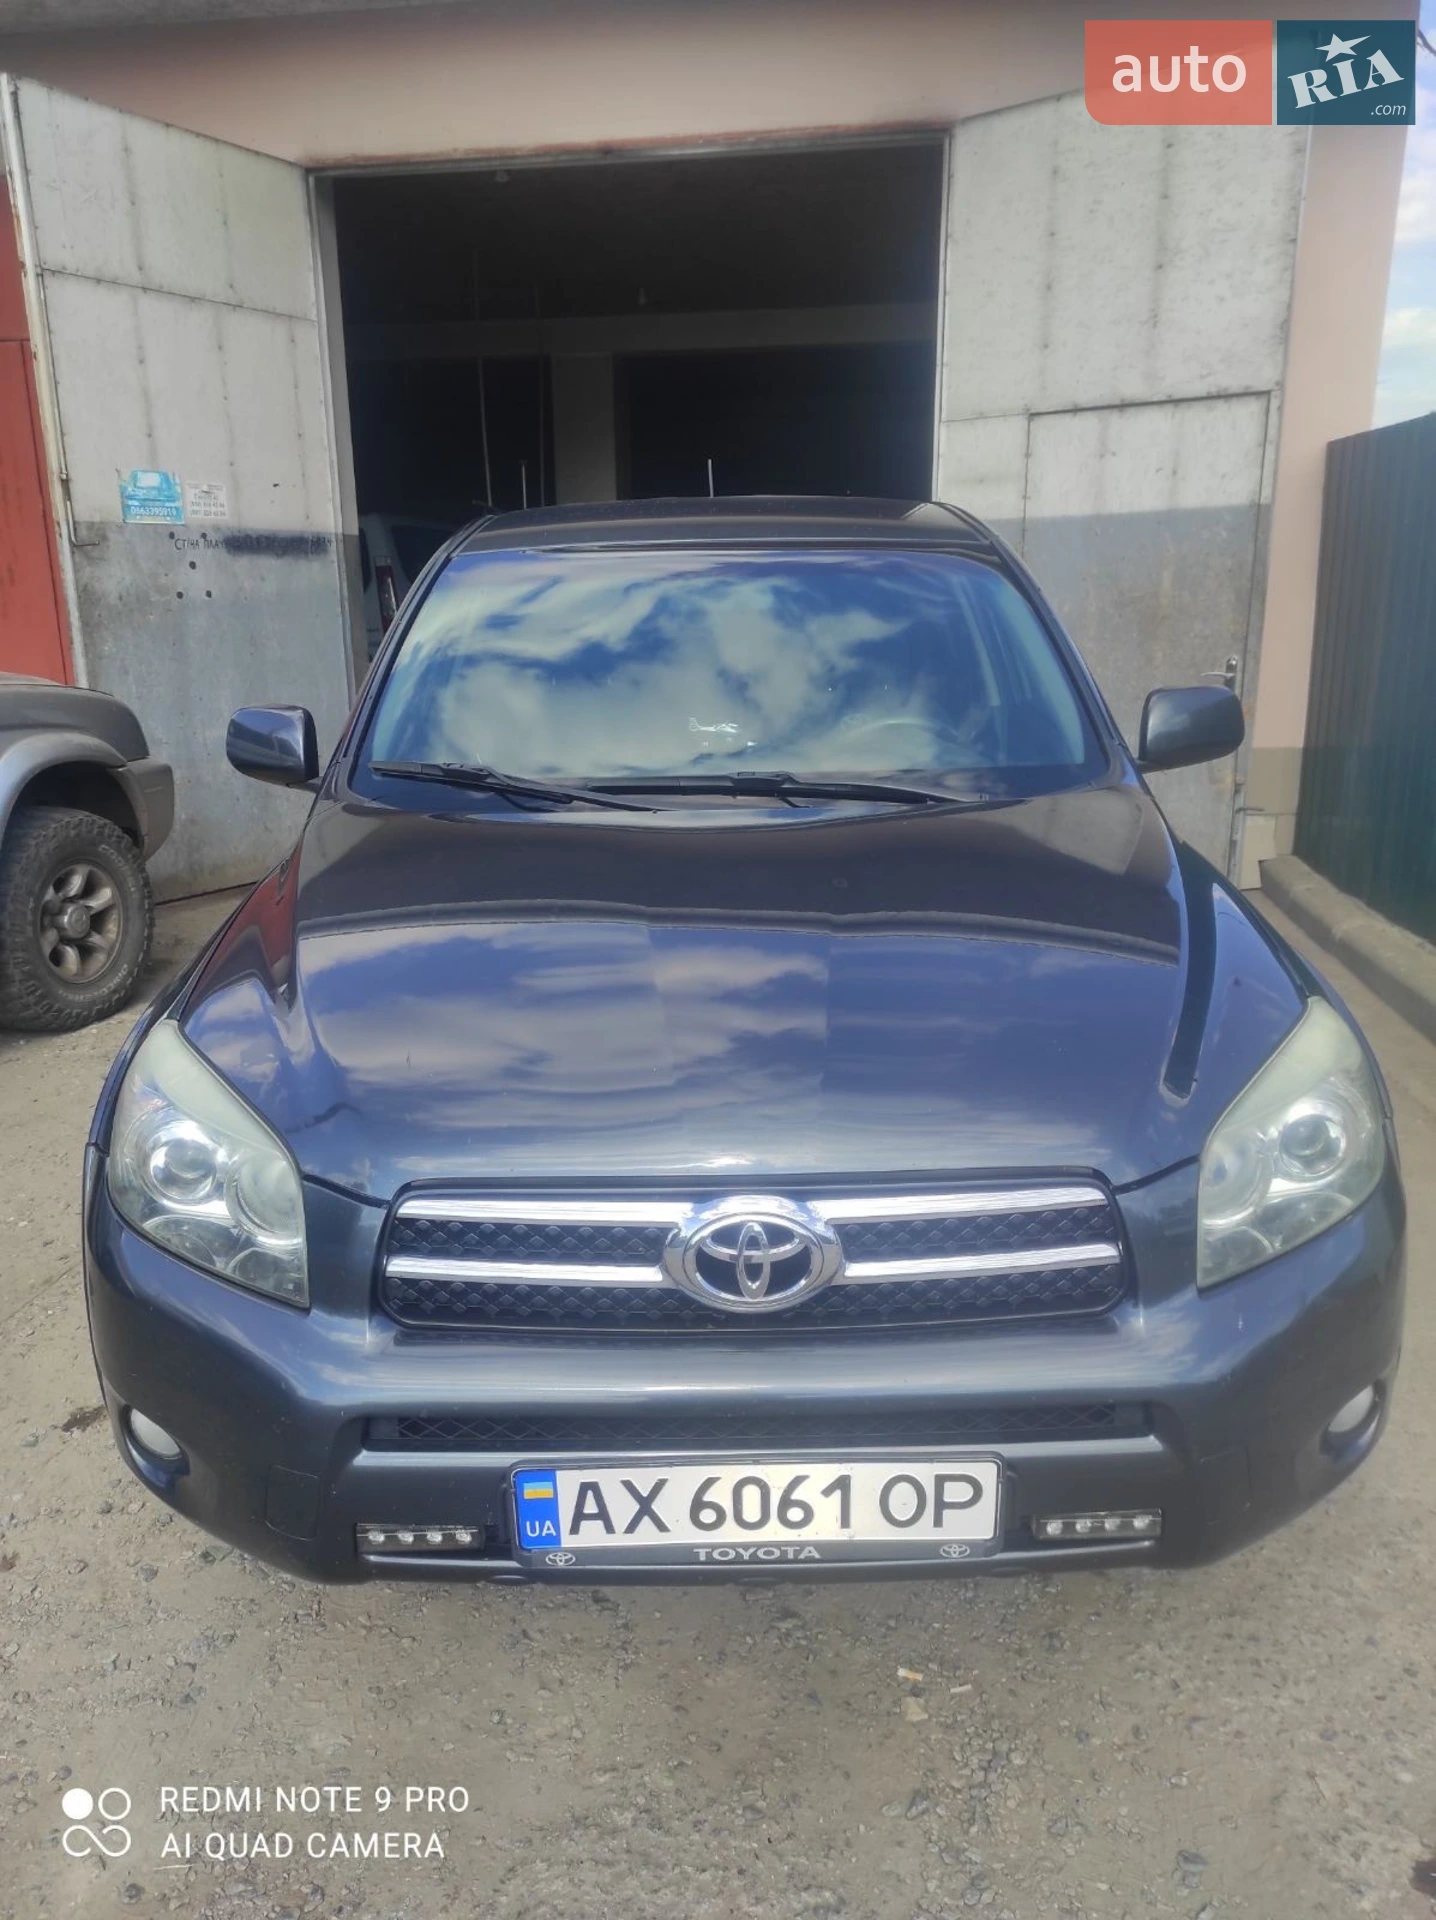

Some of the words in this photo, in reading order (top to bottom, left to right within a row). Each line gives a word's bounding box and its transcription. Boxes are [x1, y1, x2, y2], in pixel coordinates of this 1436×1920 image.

[568, 1477, 672, 1535] AX
[689, 1474, 852, 1532] 6061
[878, 1473, 984, 1529] OP
[526, 1520, 557, 1538] UA
[693, 1546, 821, 1561] TOYOTA
